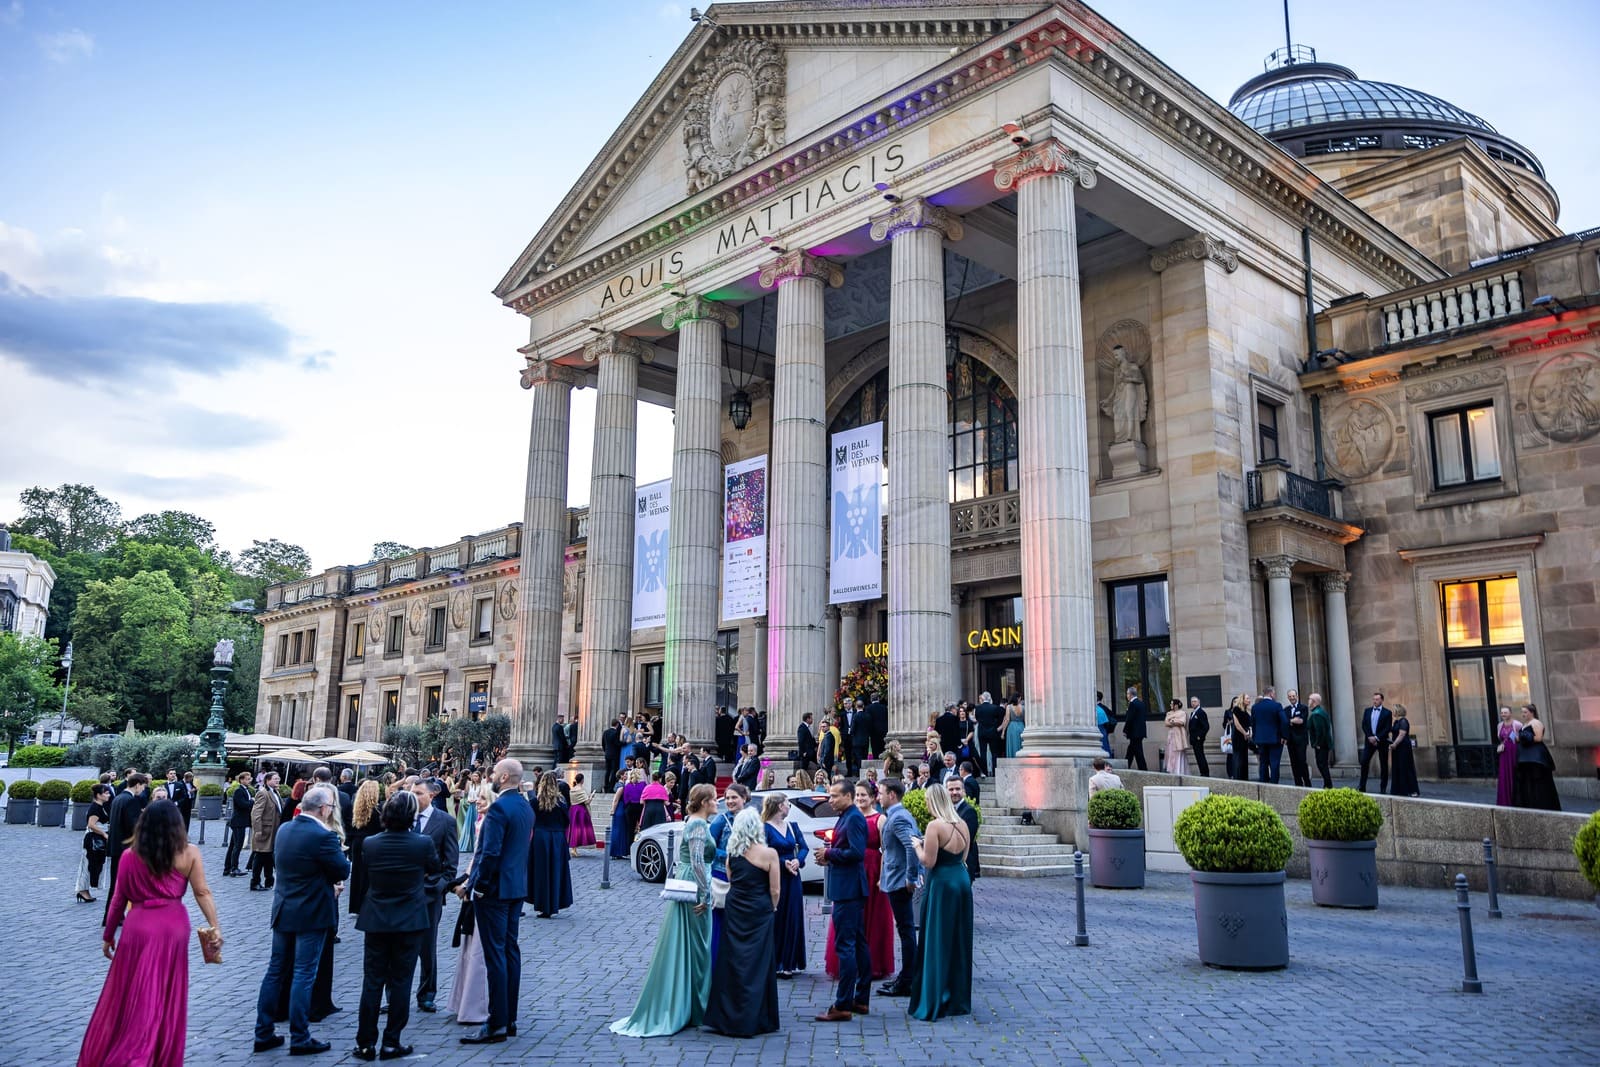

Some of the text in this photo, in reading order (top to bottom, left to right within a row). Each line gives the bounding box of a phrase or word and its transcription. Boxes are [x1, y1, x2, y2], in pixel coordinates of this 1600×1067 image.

[600, 144, 905, 308] AQUIS MATTIACIS
[851, 439, 870, 451] BALL
[851, 450, 864, 460] DES
[851, 454, 880, 469] WEINES
[649, 504, 670, 517] WEINES
